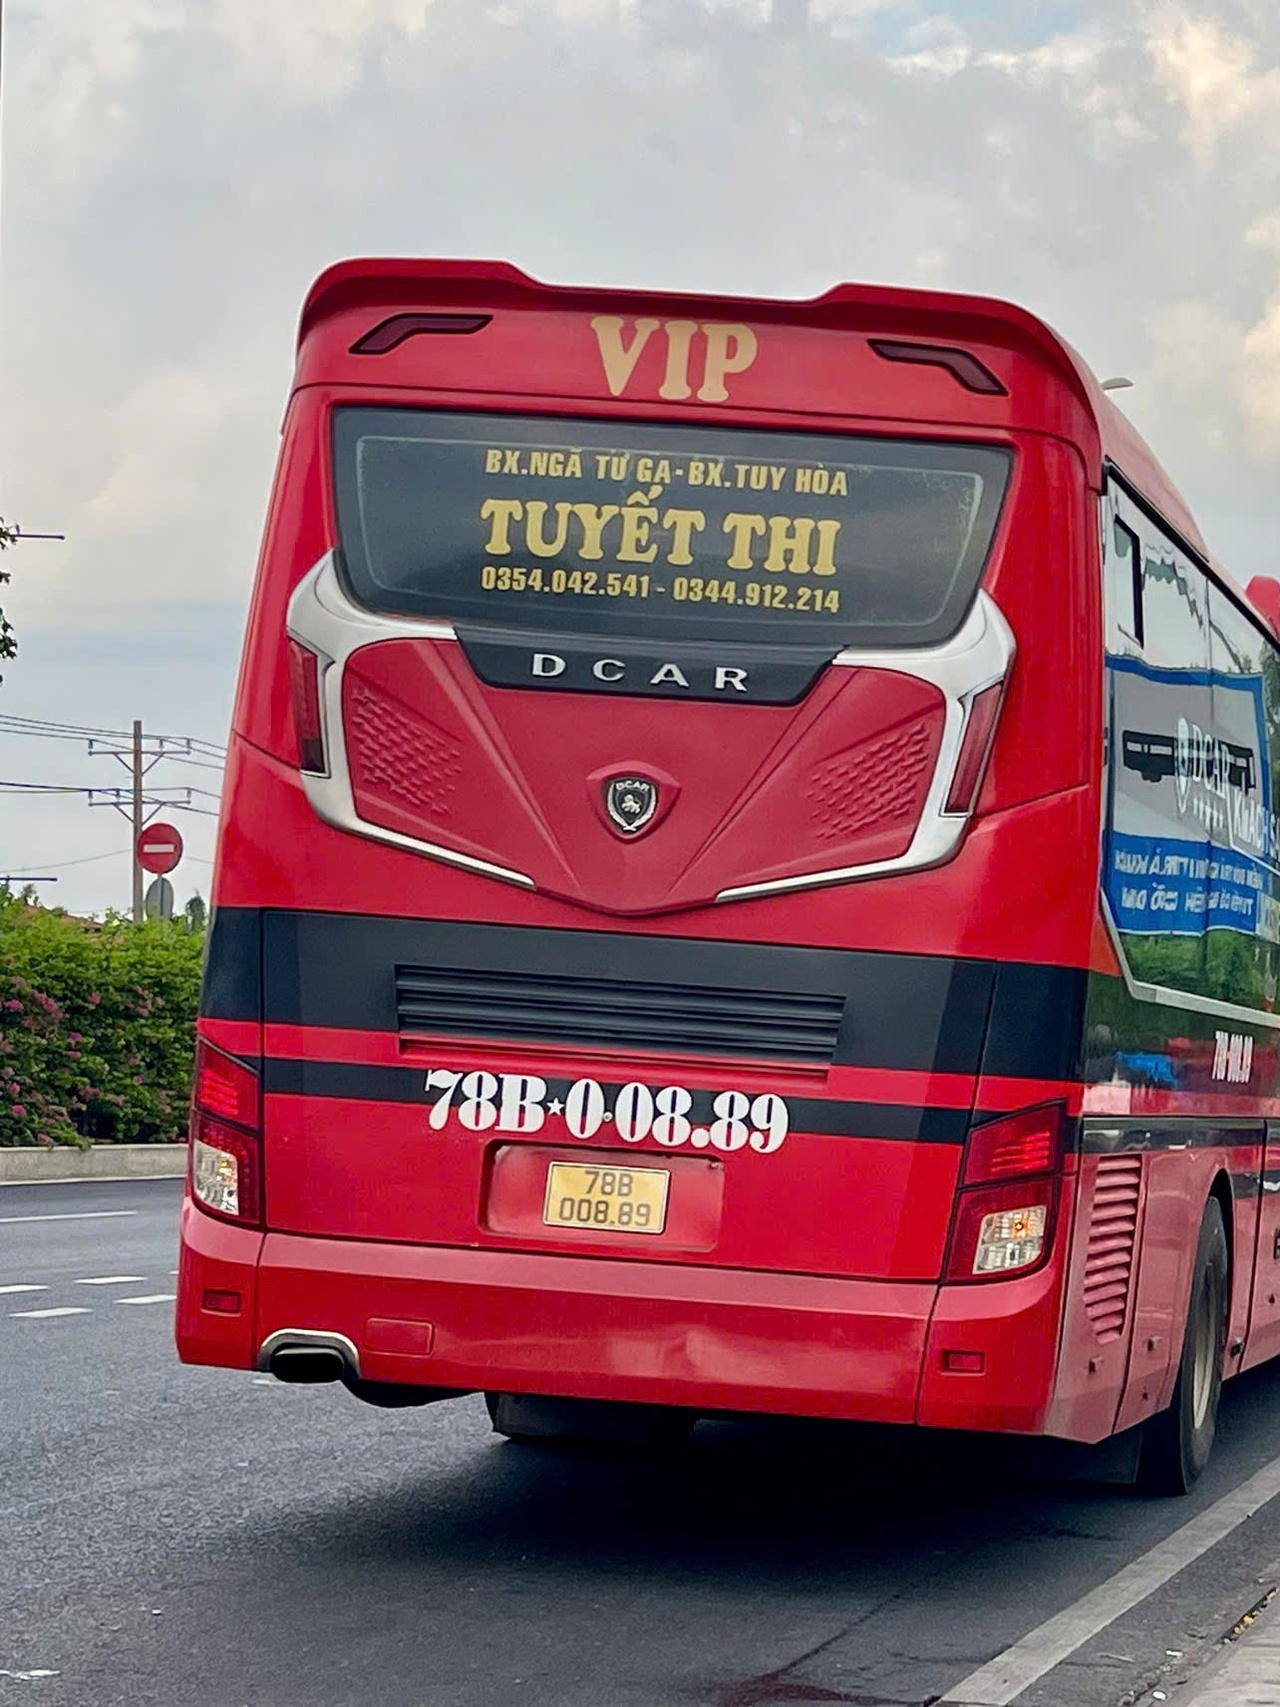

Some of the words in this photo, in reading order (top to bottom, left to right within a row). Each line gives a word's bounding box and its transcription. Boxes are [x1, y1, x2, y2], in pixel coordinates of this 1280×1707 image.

[591, 317, 757, 402] VIP
[485, 448, 583, 478] BX.NGÃ
[795, 462, 848, 496] HÒA
[480, 484, 706, 566] TUYẾT
[722, 512, 841, 576] THI
[481, 565, 650, 598] 0354.042.541
[673, 576, 841, 613] 0344.912.214
[531, 653, 749, 692] DCAR
[584, 1171, 634, 1198] 78B
[559, 1199, 651, 1227] 008.89
